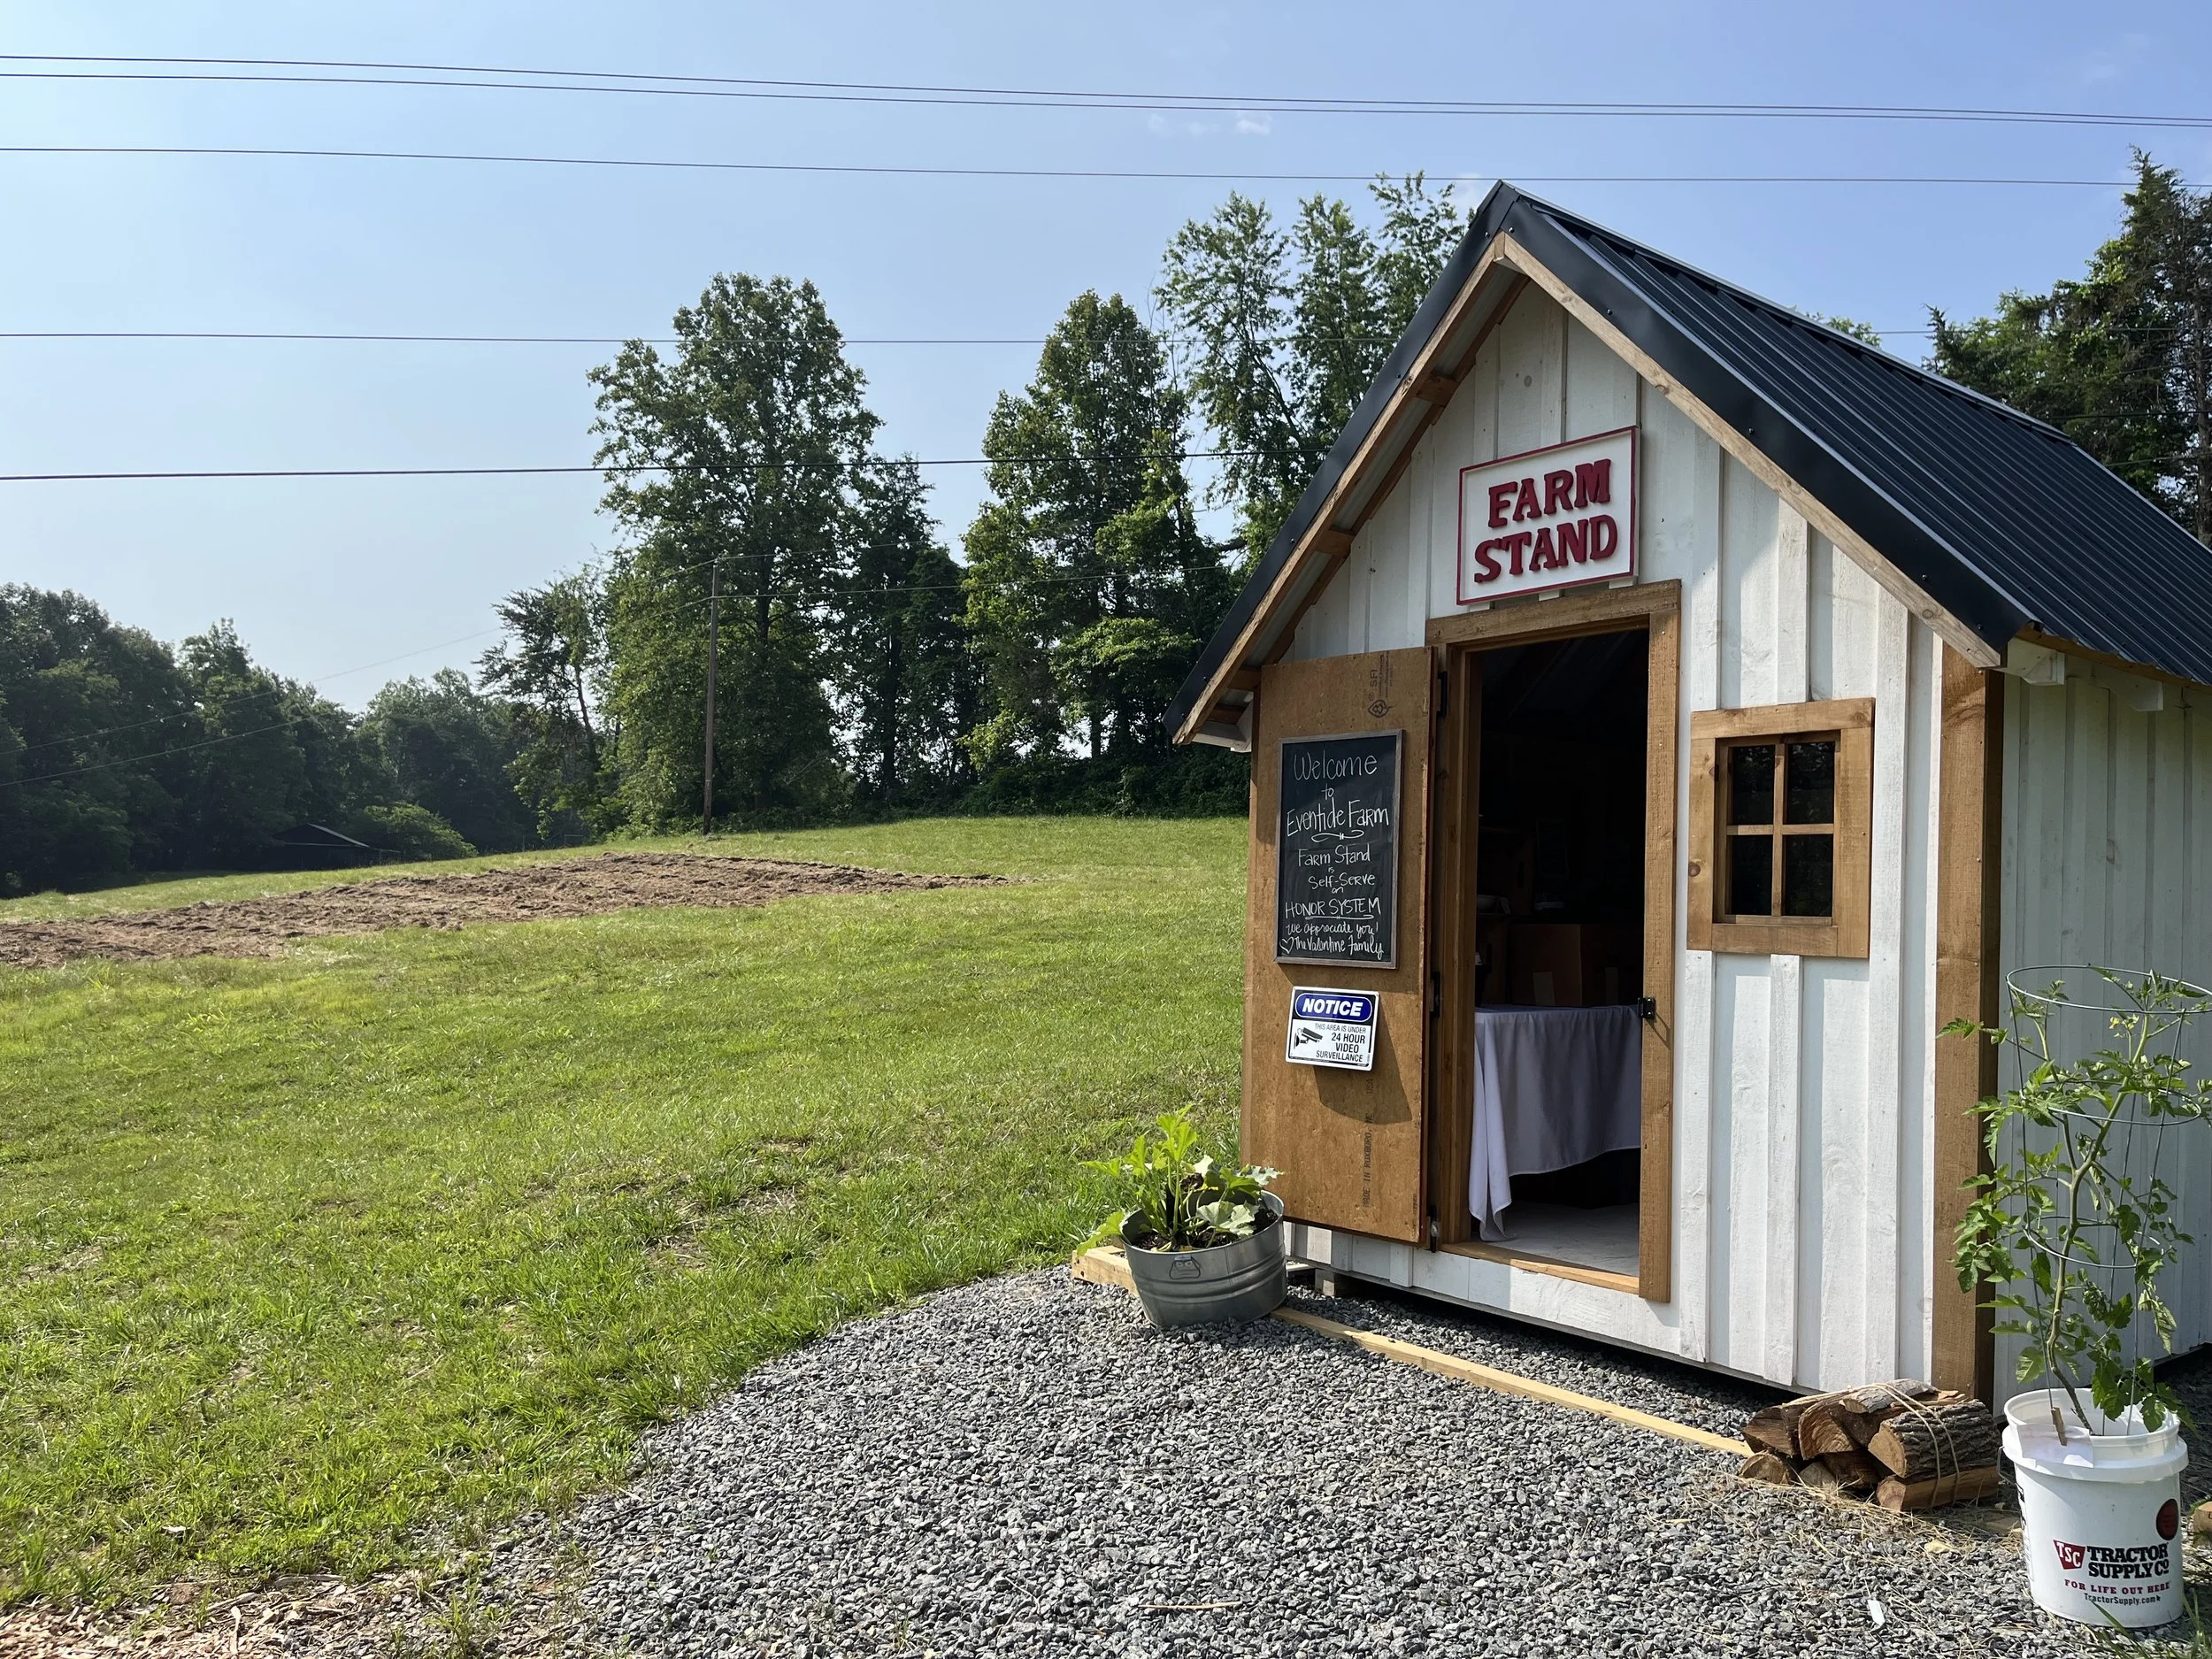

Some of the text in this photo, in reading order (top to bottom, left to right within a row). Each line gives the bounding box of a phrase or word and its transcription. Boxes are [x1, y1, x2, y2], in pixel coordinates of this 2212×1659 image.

[1488, 458, 1611, 528] FARM
[1474, 514, 1617, 583] STAND
[1294, 749, 1377, 780] Welcome
[1321, 783, 1334, 801] to
[1286, 796, 1346, 837] Eventide
[1334, 842, 1371, 865] Stand
[1328, 864, 1334, 873] is
[1285, 896, 1381, 919] HONOR SYSTEM
[1303, 921, 1354, 936] appreciate
[1294, 936, 1306, 950] The
[1307, 936, 1346, 953] Valentine
[1302, 998, 1363, 1017] NOTICE
[1332, 1033, 1366, 1044] 24 HOUR
[1316, 1049, 1363, 1062] SURVEILLANCE
[1335, 1042, 1359, 1053] VIDEO
[2056, 1541, 2081, 1568] TSC
[2086, 1543, 2168, 1563] TRACTOR
[2088, 1562, 2154, 1578] SUPPLY
[2064, 1578, 2086, 1591] FOR
[2091, 1585, 2116, 1594] LIFE
[2147, 1582, 2170, 1593] HERE
[2084, 1593, 2157, 1606] TractorSupply.com
